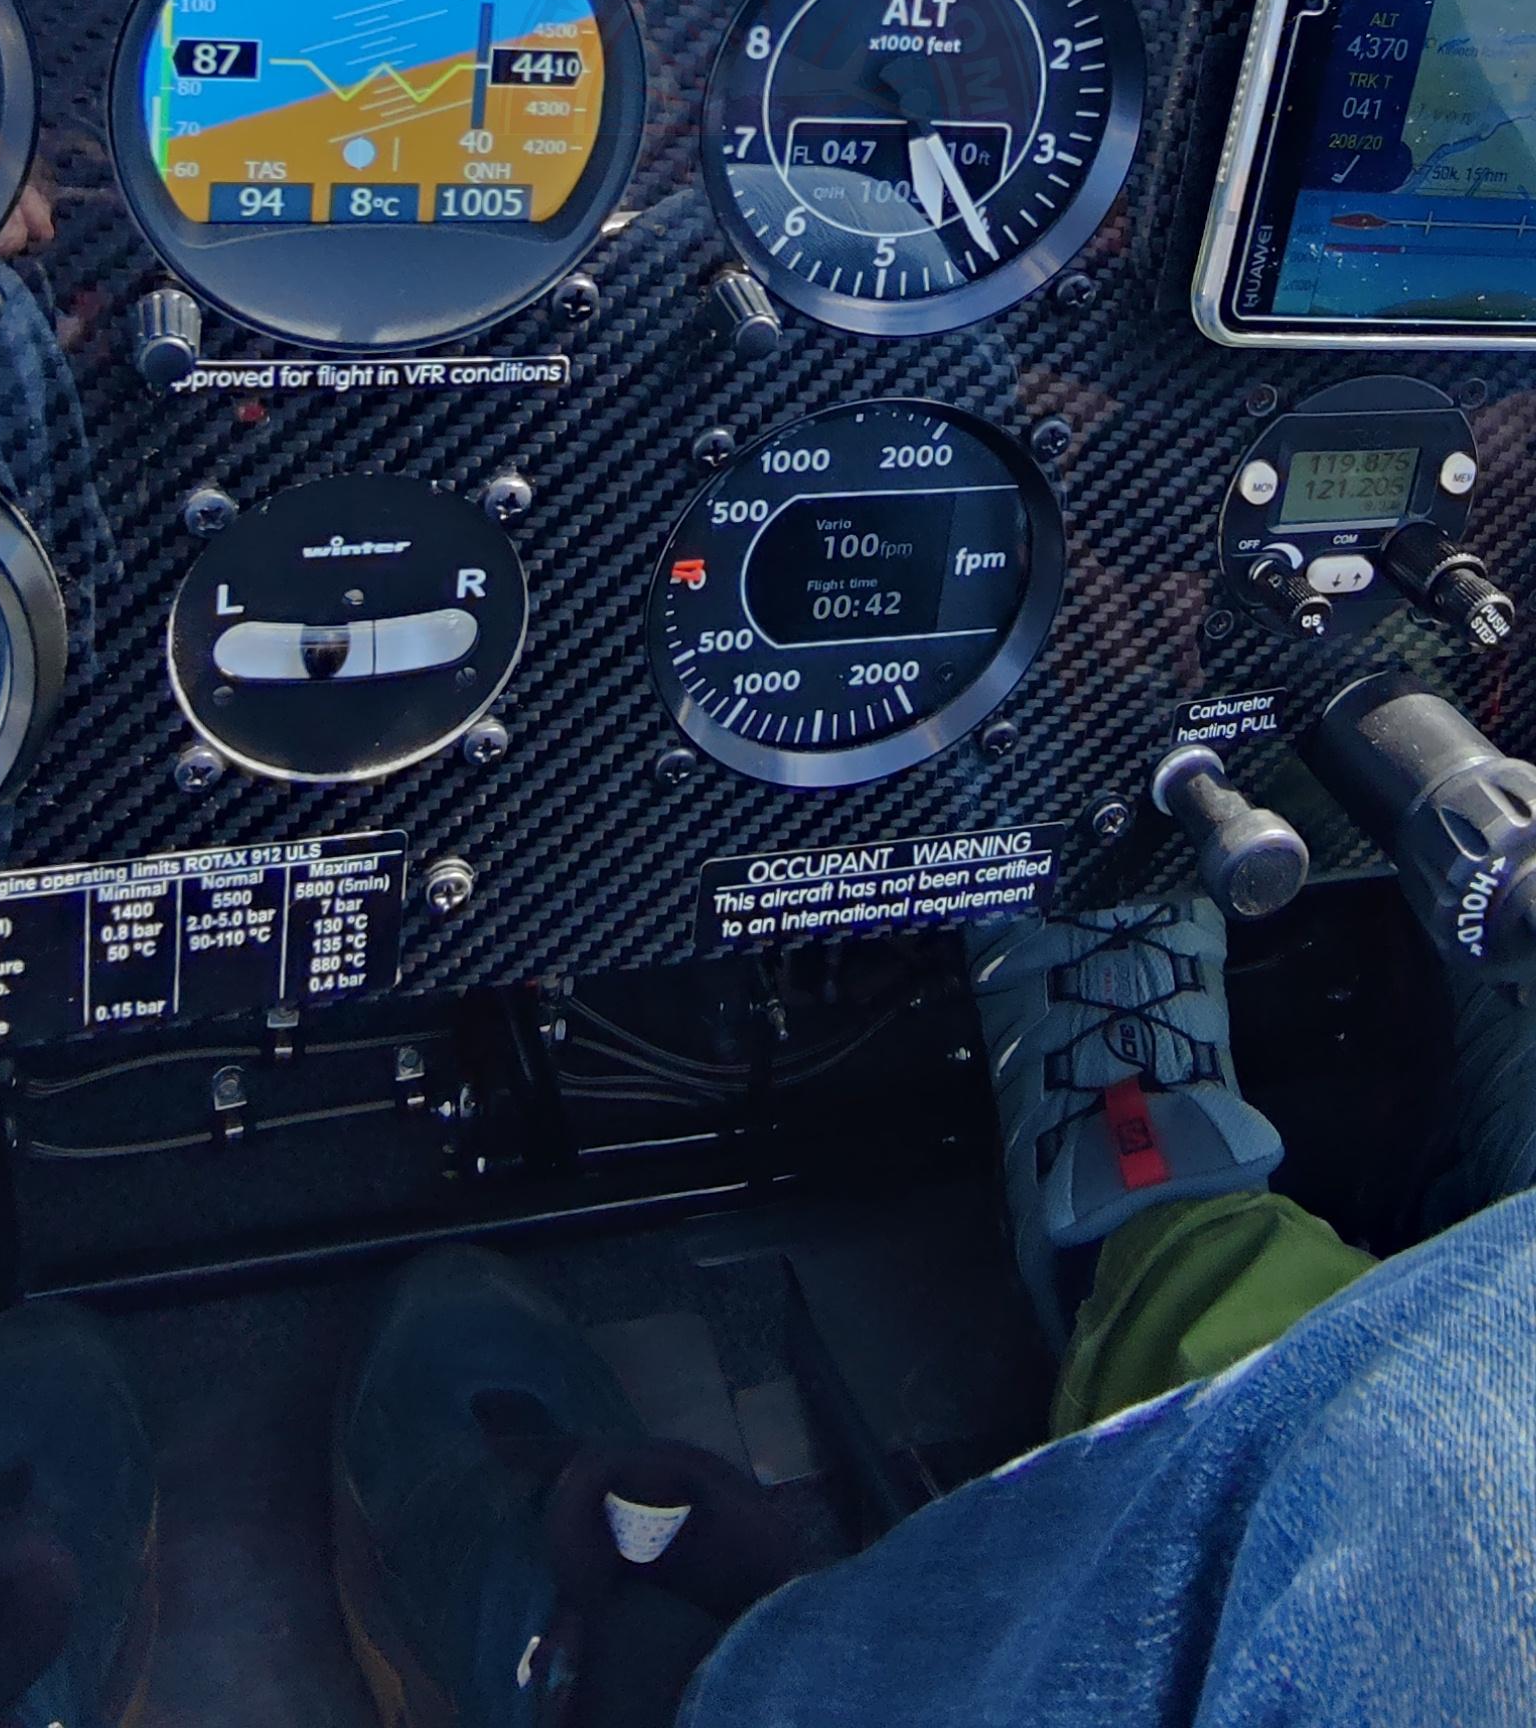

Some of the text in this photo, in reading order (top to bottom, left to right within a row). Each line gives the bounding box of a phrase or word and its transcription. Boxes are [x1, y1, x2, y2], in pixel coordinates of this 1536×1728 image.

[869, 35, 961, 55] x1000 feet
[1347, 36, 1408, 61] 4,370
[193, 43, 241, 74] 87
[1342, 97, 1382, 120] 041
[793, 141, 877, 165] FL 047
[245, 161, 286, 180] TAS
[464, 162, 511, 183] QNH
[239, 188, 284, 216] 94
[442, 189, 523, 216] 1005
[1242, 224, 1274, 309] HUAWEI
[280, 362, 561, 391] for flight in VFR conditions
[761, 448, 830, 473] 1000
[880, 445, 953, 468] 2000
[711, 500, 768, 524] 500
[816, 519, 852, 530] Vario
[303, 536, 412, 558] winter
[824, 533, 913, 560] 100 fpm
[1238, 540, 1261, 551] OFF
[1333, 534, 1358, 545] COM
[955, 549, 1006, 576] fpm
[456, 569, 486, 599] R
[807, 577, 878, 593] Flight time
[216, 584, 244, 616] L
[813, 592, 902, 620] 00:42
[1470, 616, 1497, 645] STEP
[1481, 603, 1511, 637] PUSH
[1188, 694, 1274, 721] Carburetor
[1176, 712, 1278, 743] heating PULL
[41, 866, 126, 889] operating
[132, 860, 180, 878] limits
[184, 852, 248, 871] ROTAX
[251, 848, 282, 865] 912
[286, 844, 321, 861] ULS
[310, 856, 378, 878] Maximal
[748, 832, 1032, 884] OCCUPANT WARNING
[98, 880, 167, 902] Minimal
[201, 870, 264, 890] Normal
[294, 874, 390, 899] 5800 (5min)
[714, 856, 1051, 914] This aircraft has not been certified
[112, 902, 154, 920] 1400
[212, 890, 252, 908] 5500
[321, 898, 362, 914] 7 bar
[722, 883, 1035, 938] to an international requirement
[1457, 872, 1499, 943] HOLD
[186, 908, 276, 932] 2.0-5.0 bar
[314, 918, 342, 935] 130
[101, 922, 163, 943] 0.8 bar
[189, 930, 245, 950] 90-110
[107, 944, 130, 962] 50
[312, 937, 342, 954] 135
[311, 956, 342, 974] 880
[309, 976, 335, 992] 0.4
[96, 1002, 132, 1022] 0.15
